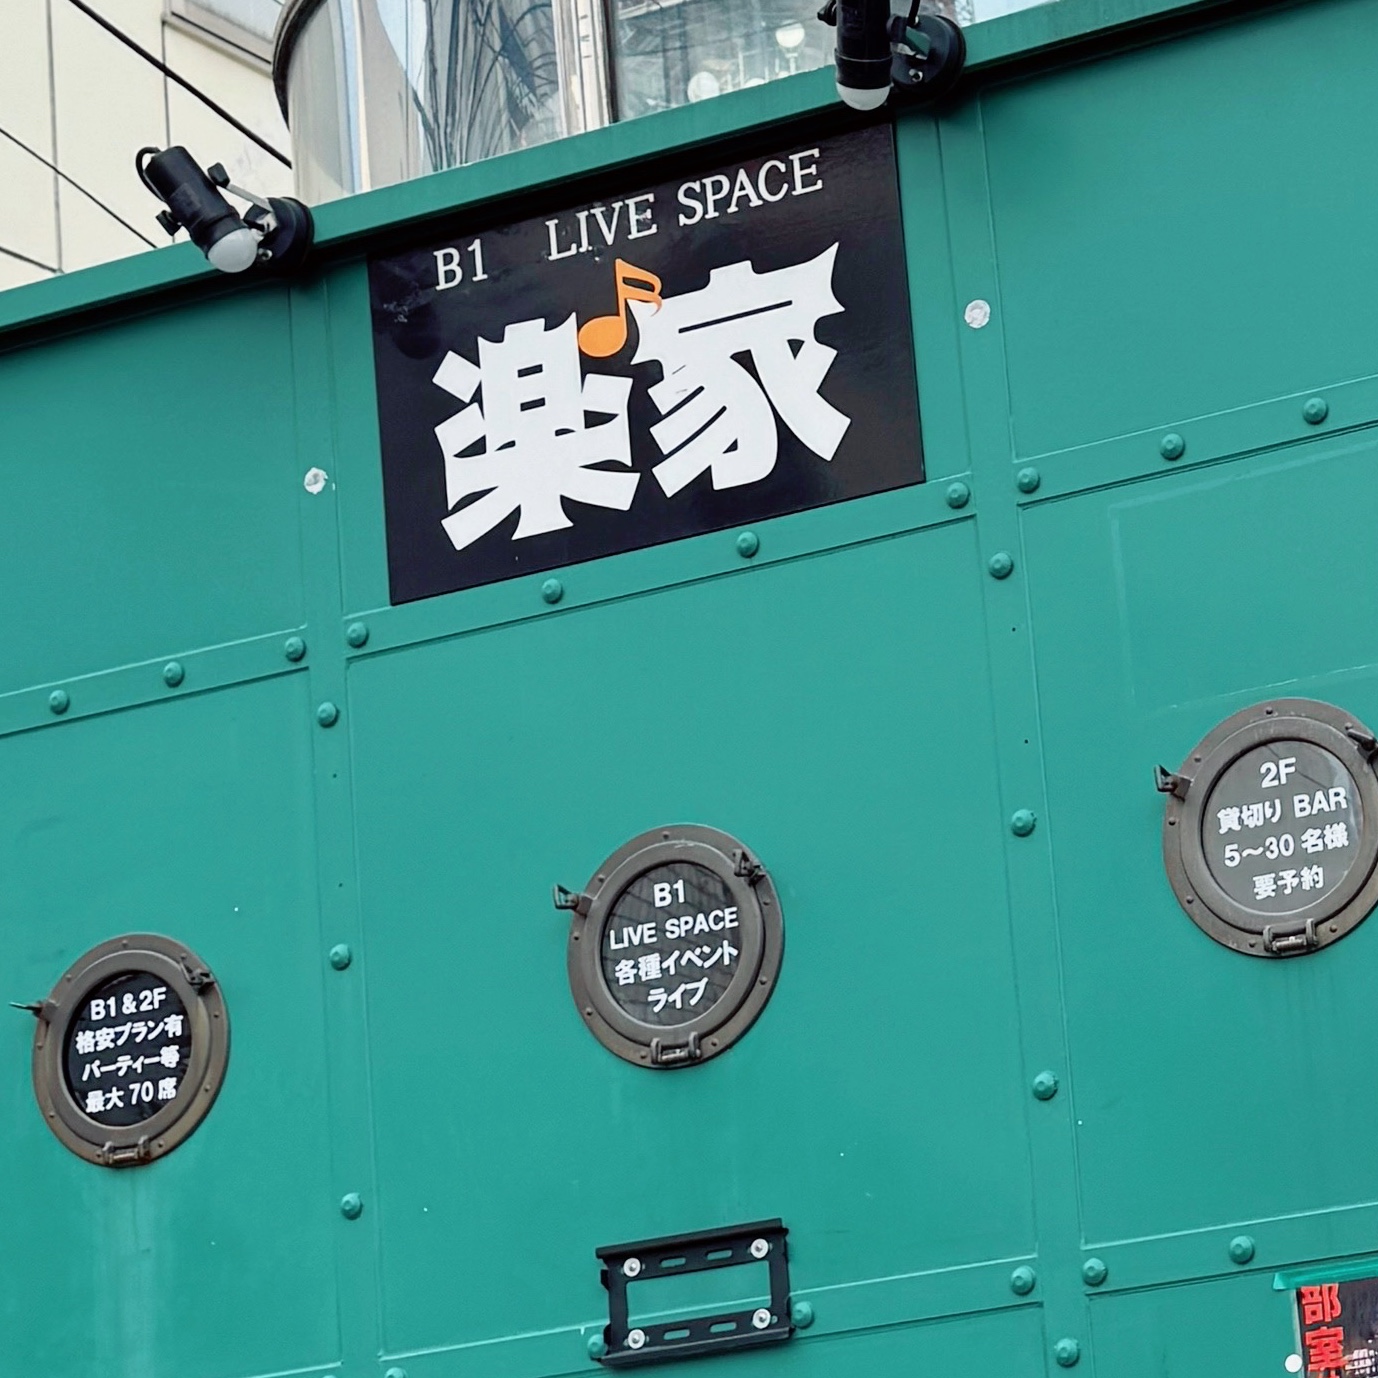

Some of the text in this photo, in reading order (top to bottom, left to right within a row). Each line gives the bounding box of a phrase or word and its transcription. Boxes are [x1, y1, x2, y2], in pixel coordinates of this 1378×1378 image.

[433, 148, 823, 291] B1 LIVE SPACE
[432, 242, 852, 551] 楽家
[1259, 757, 1297, 788] 2F
[1293, 787, 1348, 819] BAR
[653, 879, 686, 908] B1
[1252, 865, 1325, 900] 要予約
[609, 907, 739, 950] LIVE SPACE
[614, 940, 739, 986] 各種イベント
[75, 1014, 184, 1054] 格安プラン有
[81, 1045, 180, 1081] パーティー等
